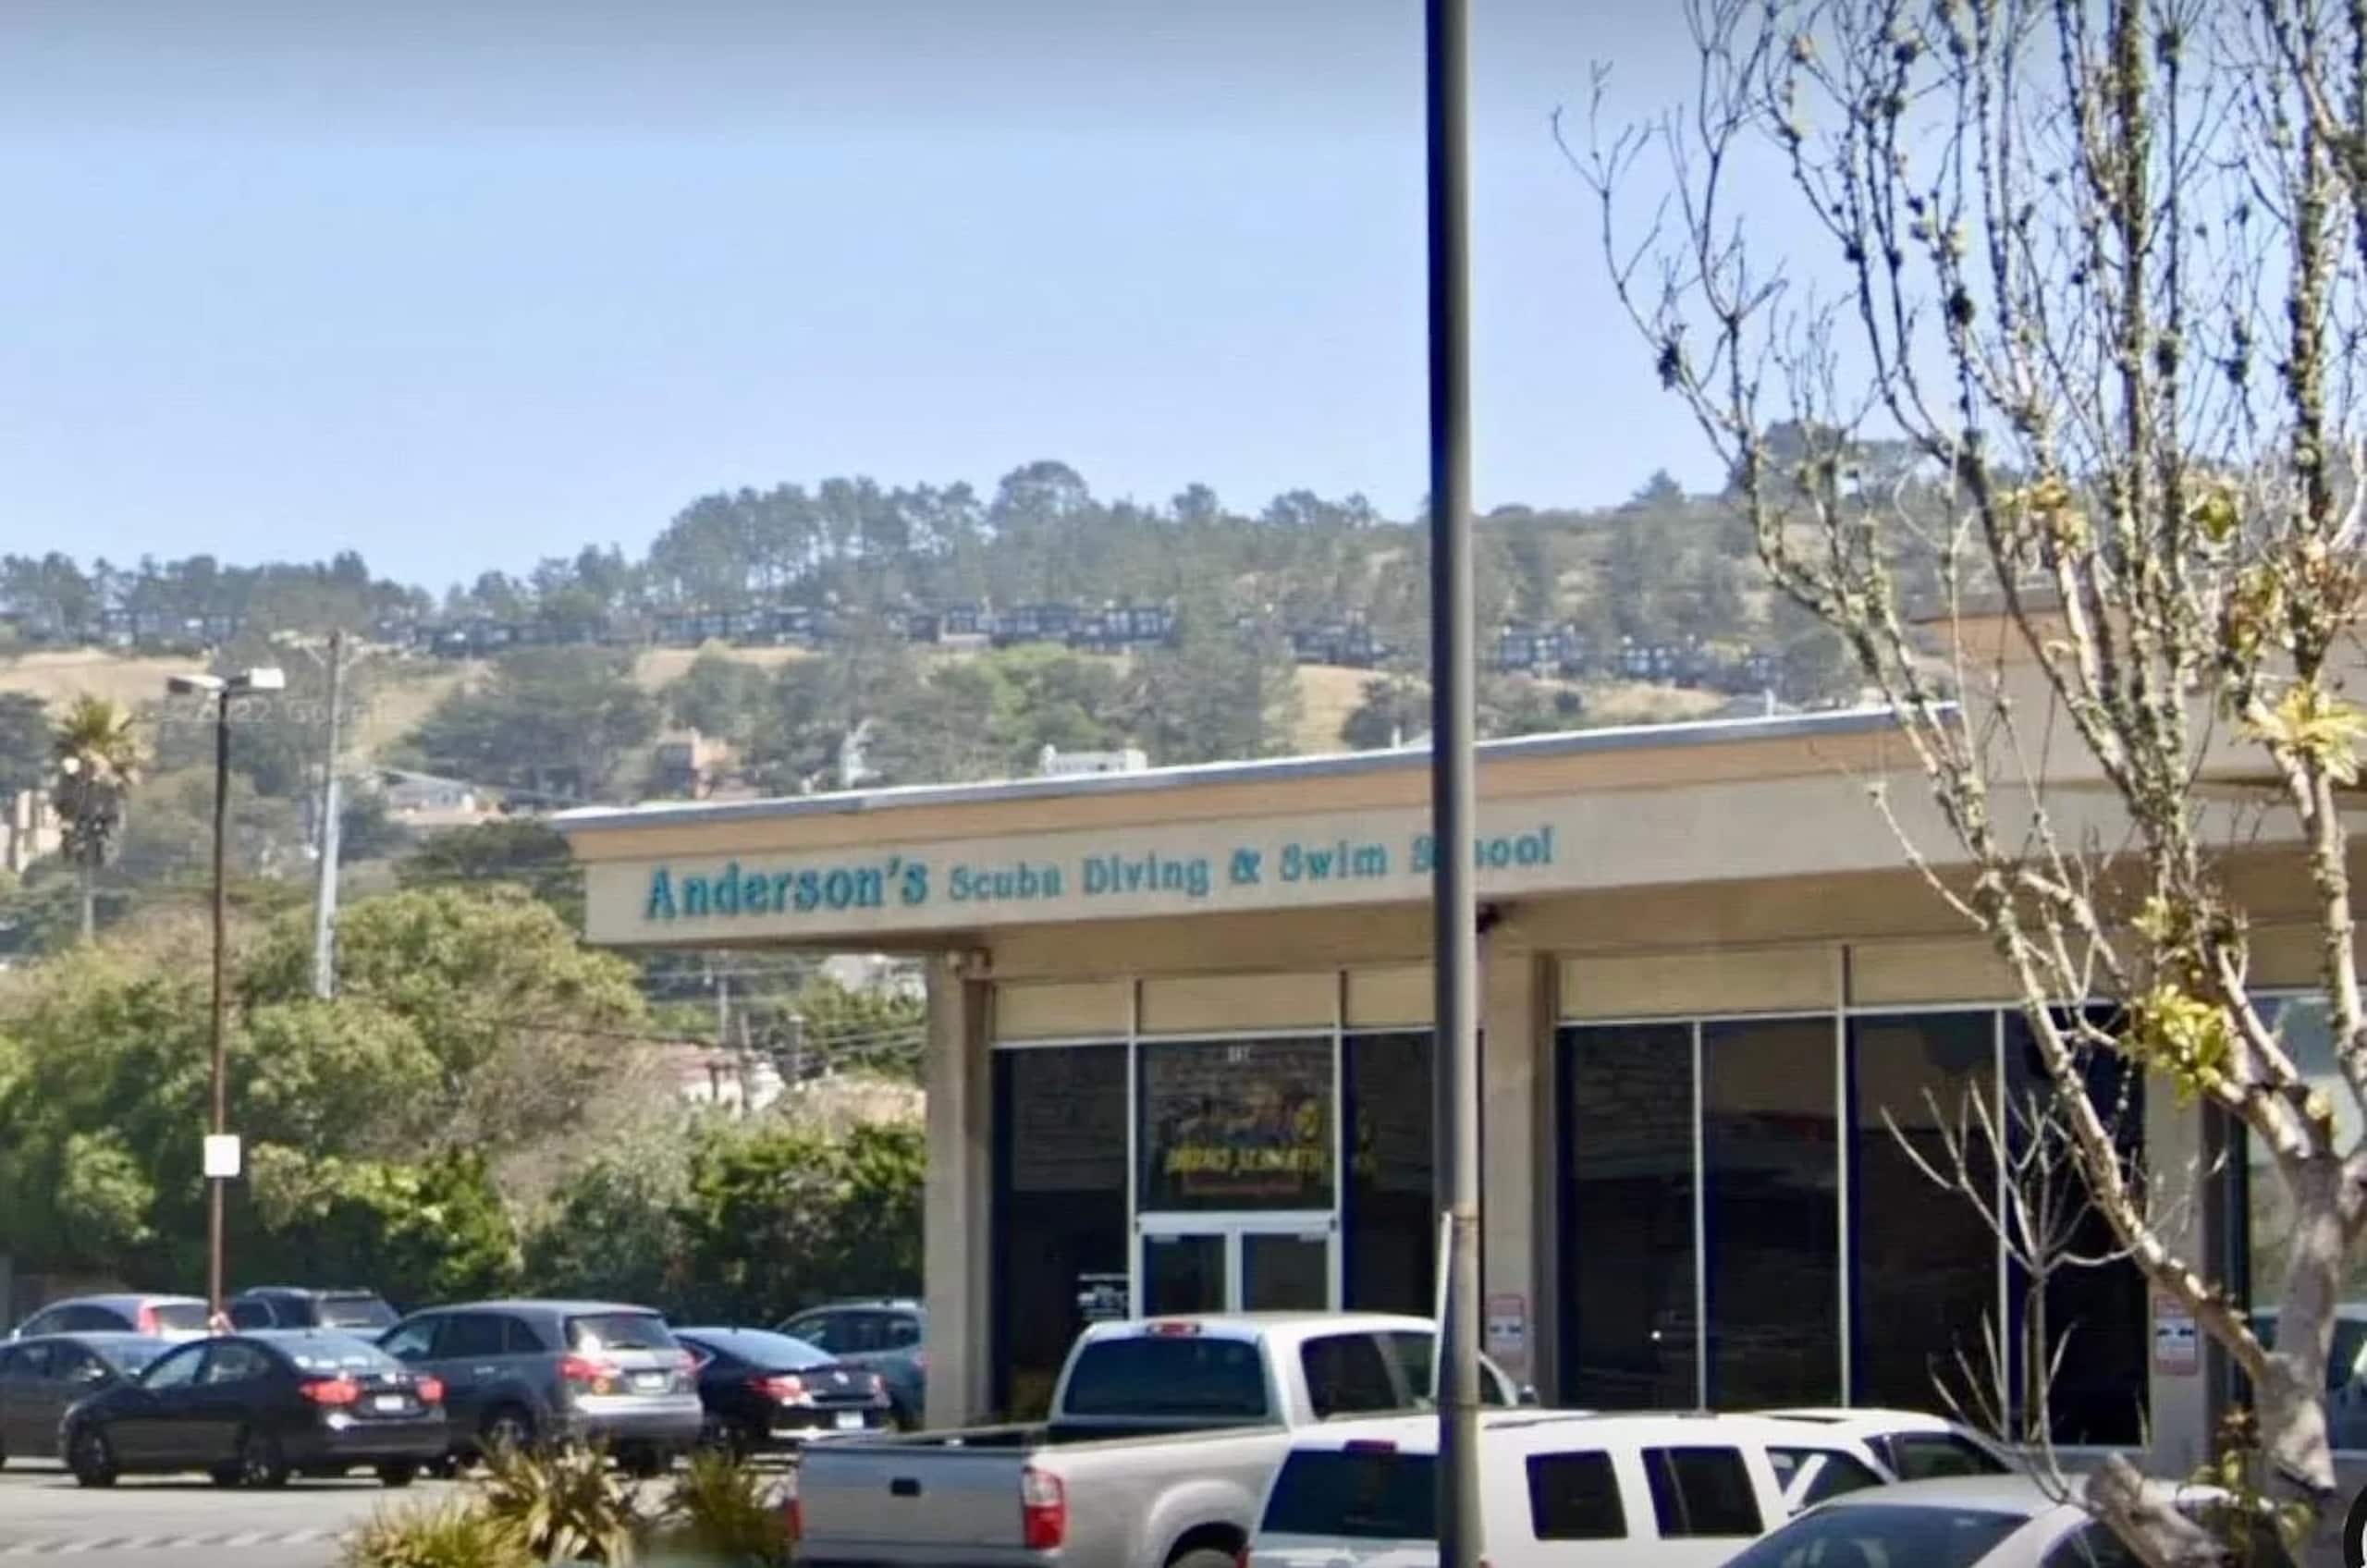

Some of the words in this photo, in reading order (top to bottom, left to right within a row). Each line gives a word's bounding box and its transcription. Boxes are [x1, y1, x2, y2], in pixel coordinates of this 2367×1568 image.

[644, 856, 929, 920] Anderson's
[948, 860, 1062, 901] Scuba
[1083, 850, 1210, 897] Diving
[1230, 847, 1260, 884] &
[1280, 839, 1388, 883] Swim
[1410, 826, 1553, 874] Sool
